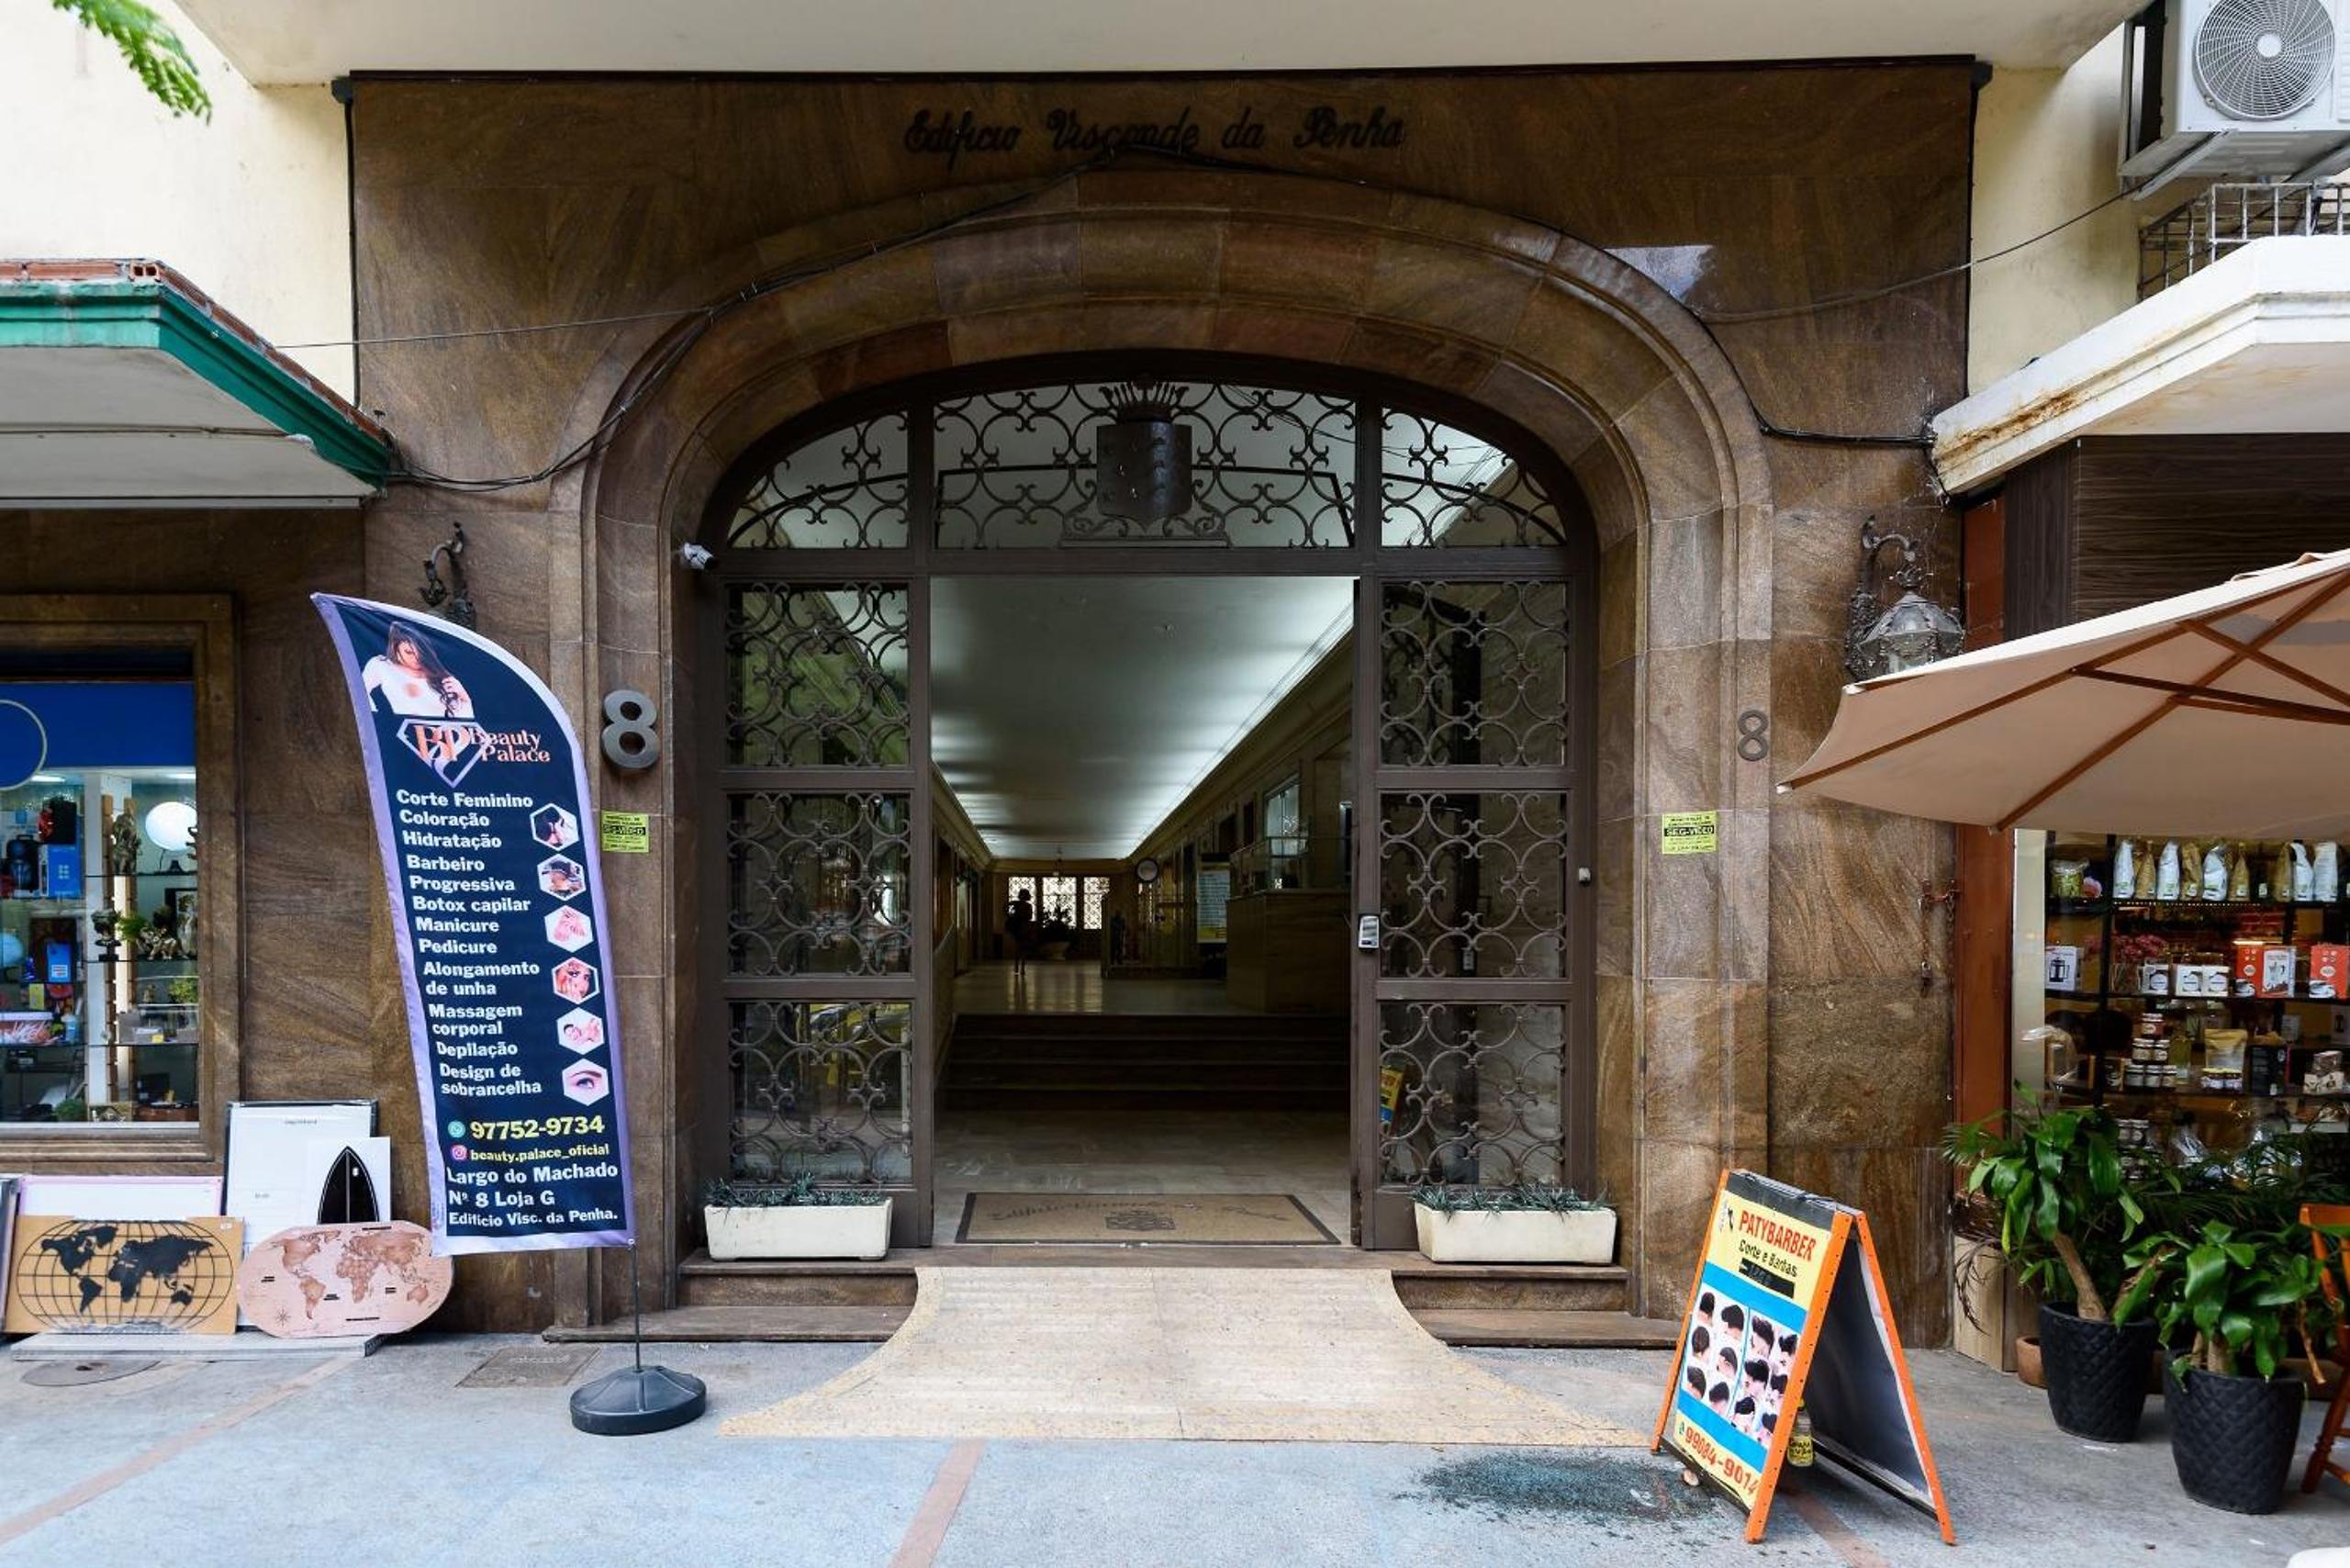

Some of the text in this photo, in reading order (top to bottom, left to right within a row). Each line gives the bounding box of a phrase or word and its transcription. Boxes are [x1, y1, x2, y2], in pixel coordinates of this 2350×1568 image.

[1046, 106, 1202, 156] Visconde
[1222, 106, 1265, 151] da
[1293, 106, 1404, 151] Penha
[469, 727, 542, 749] Beauty
[602, 689, 658, 769] 8
[1738, 710, 1769, 762] 8
[481, 745, 551, 763] Palace
[396, 789, 533, 808] Corte Feminino
[399, 809, 490, 829] Coloração
[402, 830, 502, 851] Hidratação
[406, 854, 486, 871] Barbeiro
[408, 875, 516, 894] Progressiva
[412, 895, 532, 914] Botox capilar
[415, 916, 500, 933] Manicure
[418, 937, 498, 955] Pedicure
[423, 961, 540, 979] Alongamento
[425, 980, 497, 996] de unha
[428, 1003, 523, 1020] Massagem
[431, 1020, 503, 1037] corporal
[435, 1041, 519, 1059] Depilação
[439, 1062, 521, 1081] Design de
[441, 1079, 543, 1097] sobrancelha
[470, 1114, 606, 1140] 97752-9734
[470, 1143, 610, 1165] beauty.palace_oficial
[446, 1161, 619, 1187] Largo do Machado
[475, 1192, 489, 1208] 8
[494, 1191, 534, 1208] Loja
[540, 1190, 555, 1205] G
[506, 1212, 543, 1226] Visc.
[545, 1212, 565, 1224] da
[568, 1207, 618, 1223] Penha.
[1739, 1209, 1817, 1261] PATYBARBER
[1739, 1238, 1761, 1260] Corte
[1762, 1251, 1768, 1263] e
